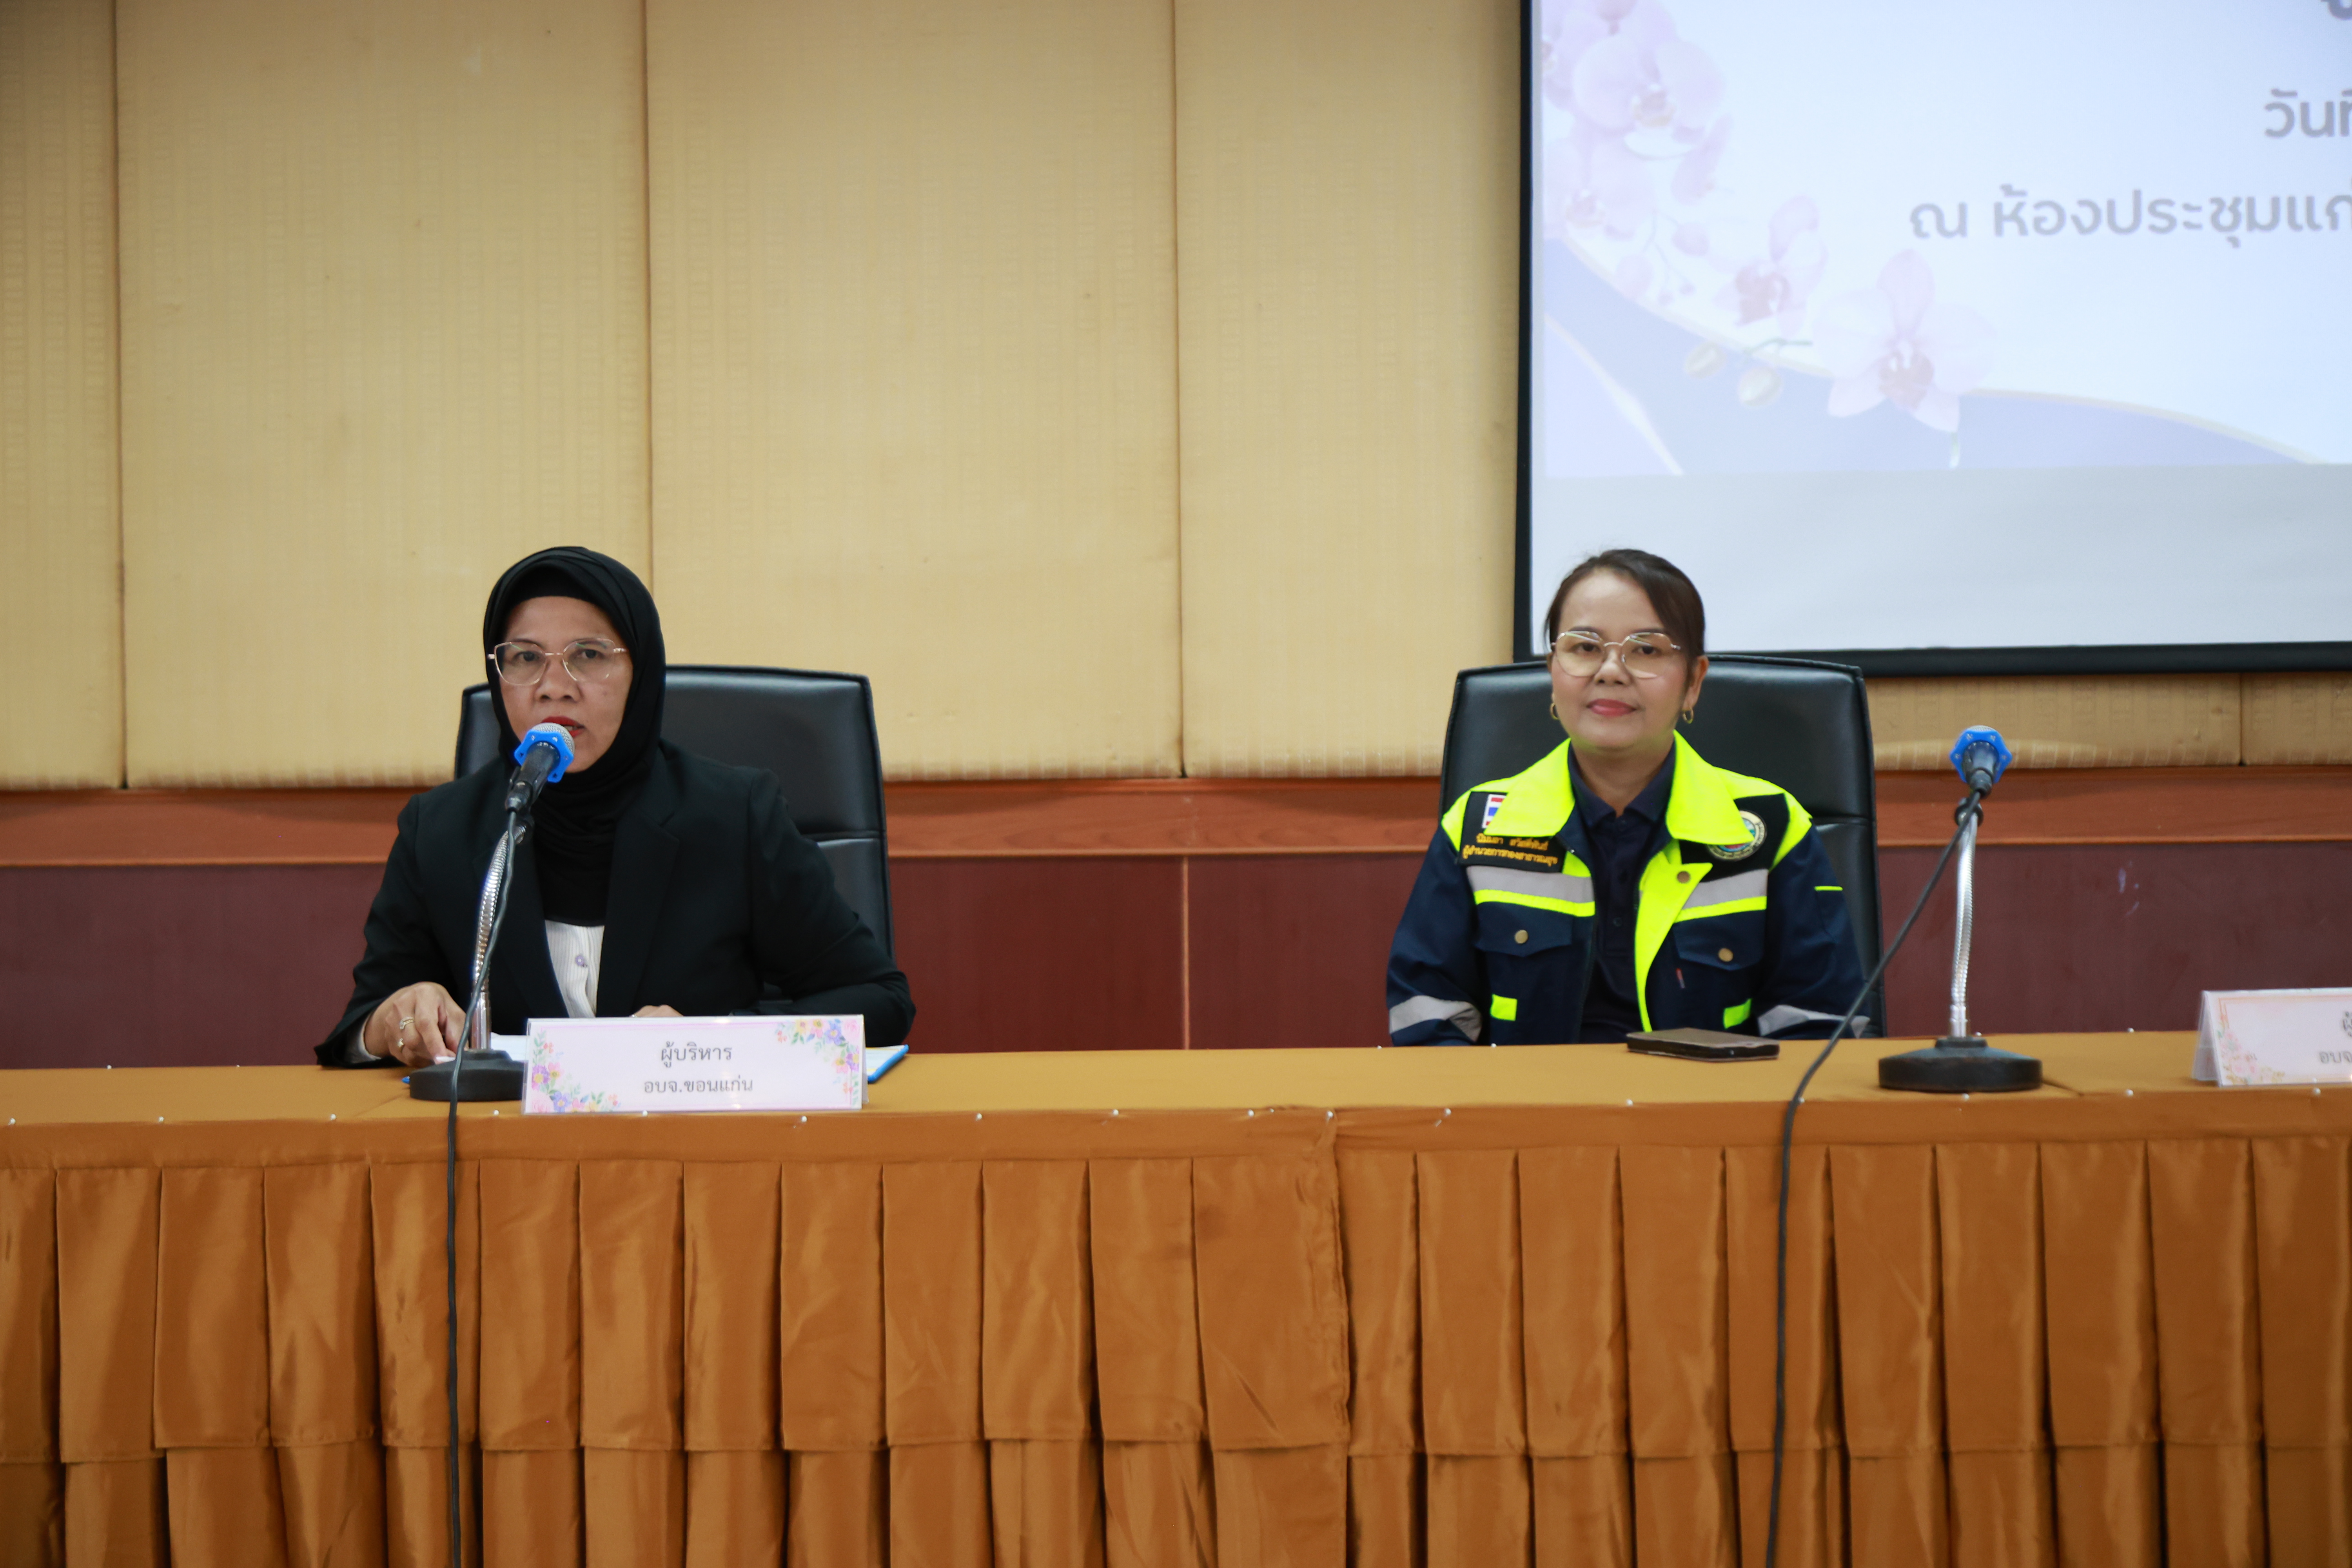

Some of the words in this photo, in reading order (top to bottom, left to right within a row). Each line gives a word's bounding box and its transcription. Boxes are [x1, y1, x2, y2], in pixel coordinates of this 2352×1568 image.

[1909, 202, 1967, 239] ณ
[661, 1041, 732, 1068] ผู้บริหาร
[644, 1074, 753, 1093] อบจ.ขอนแก่น
